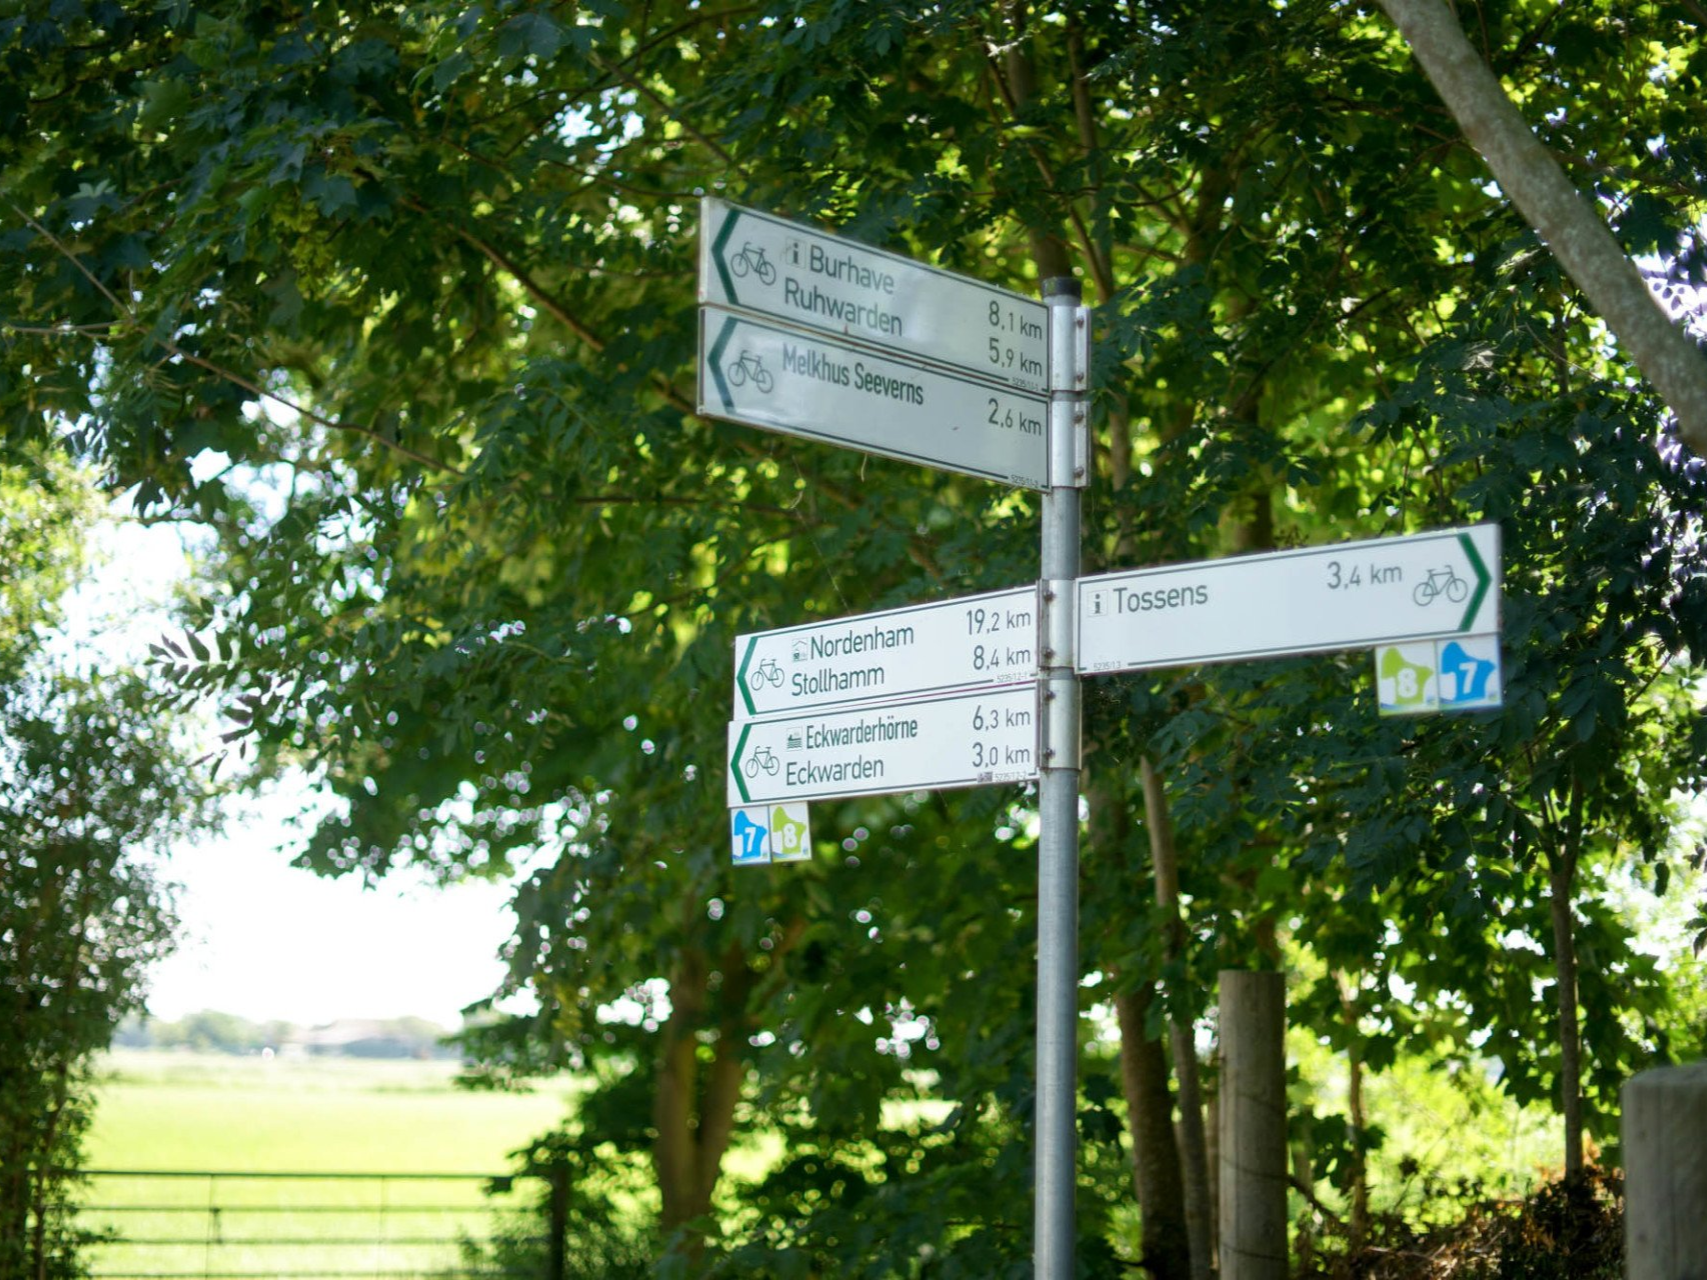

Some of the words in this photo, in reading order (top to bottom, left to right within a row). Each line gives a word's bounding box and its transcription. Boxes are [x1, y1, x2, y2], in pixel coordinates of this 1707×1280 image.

[810, 245, 894, 294] Burhave
[989, 300, 1014, 332] 8,1
[1020, 316, 1042, 340] km
[785, 277, 902, 336] Ruhwarden
[989, 337, 1014, 368] 5,9
[1020, 352, 1042, 376] km
[783, 343, 850, 387] Melkhus
[855, 363, 924, 405] Seeverns
[988, 398, 1013, 428] 2,6
[1019, 412, 1042, 436] km
[1113, 585, 1208, 614] Tossens
[1327, 561, 1361, 590] 3,4
[1371, 564, 1402, 585] km
[811, 626, 914, 660] Nordenham
[966, 608, 999, 635] 19,2
[1007, 610, 1031, 629] km
[792, 666, 885, 696] Stollhamm
[973, 645, 999, 670] 8,4
[1006, 647, 1031, 666] km
[1398, 668, 1418, 698] 8
[1459, 662, 1477, 694] 7
[806, 715, 918, 750] Eckwarderhörne
[973, 705, 999, 731] 6,3
[1006, 708, 1031, 728] km
[786, 755, 884, 786] Eckwarden
[972, 742, 998, 768] 3,0
[1005, 746, 1030, 765] km
[744, 827, 756, 847] 7
[783, 823, 797, 848] 8
